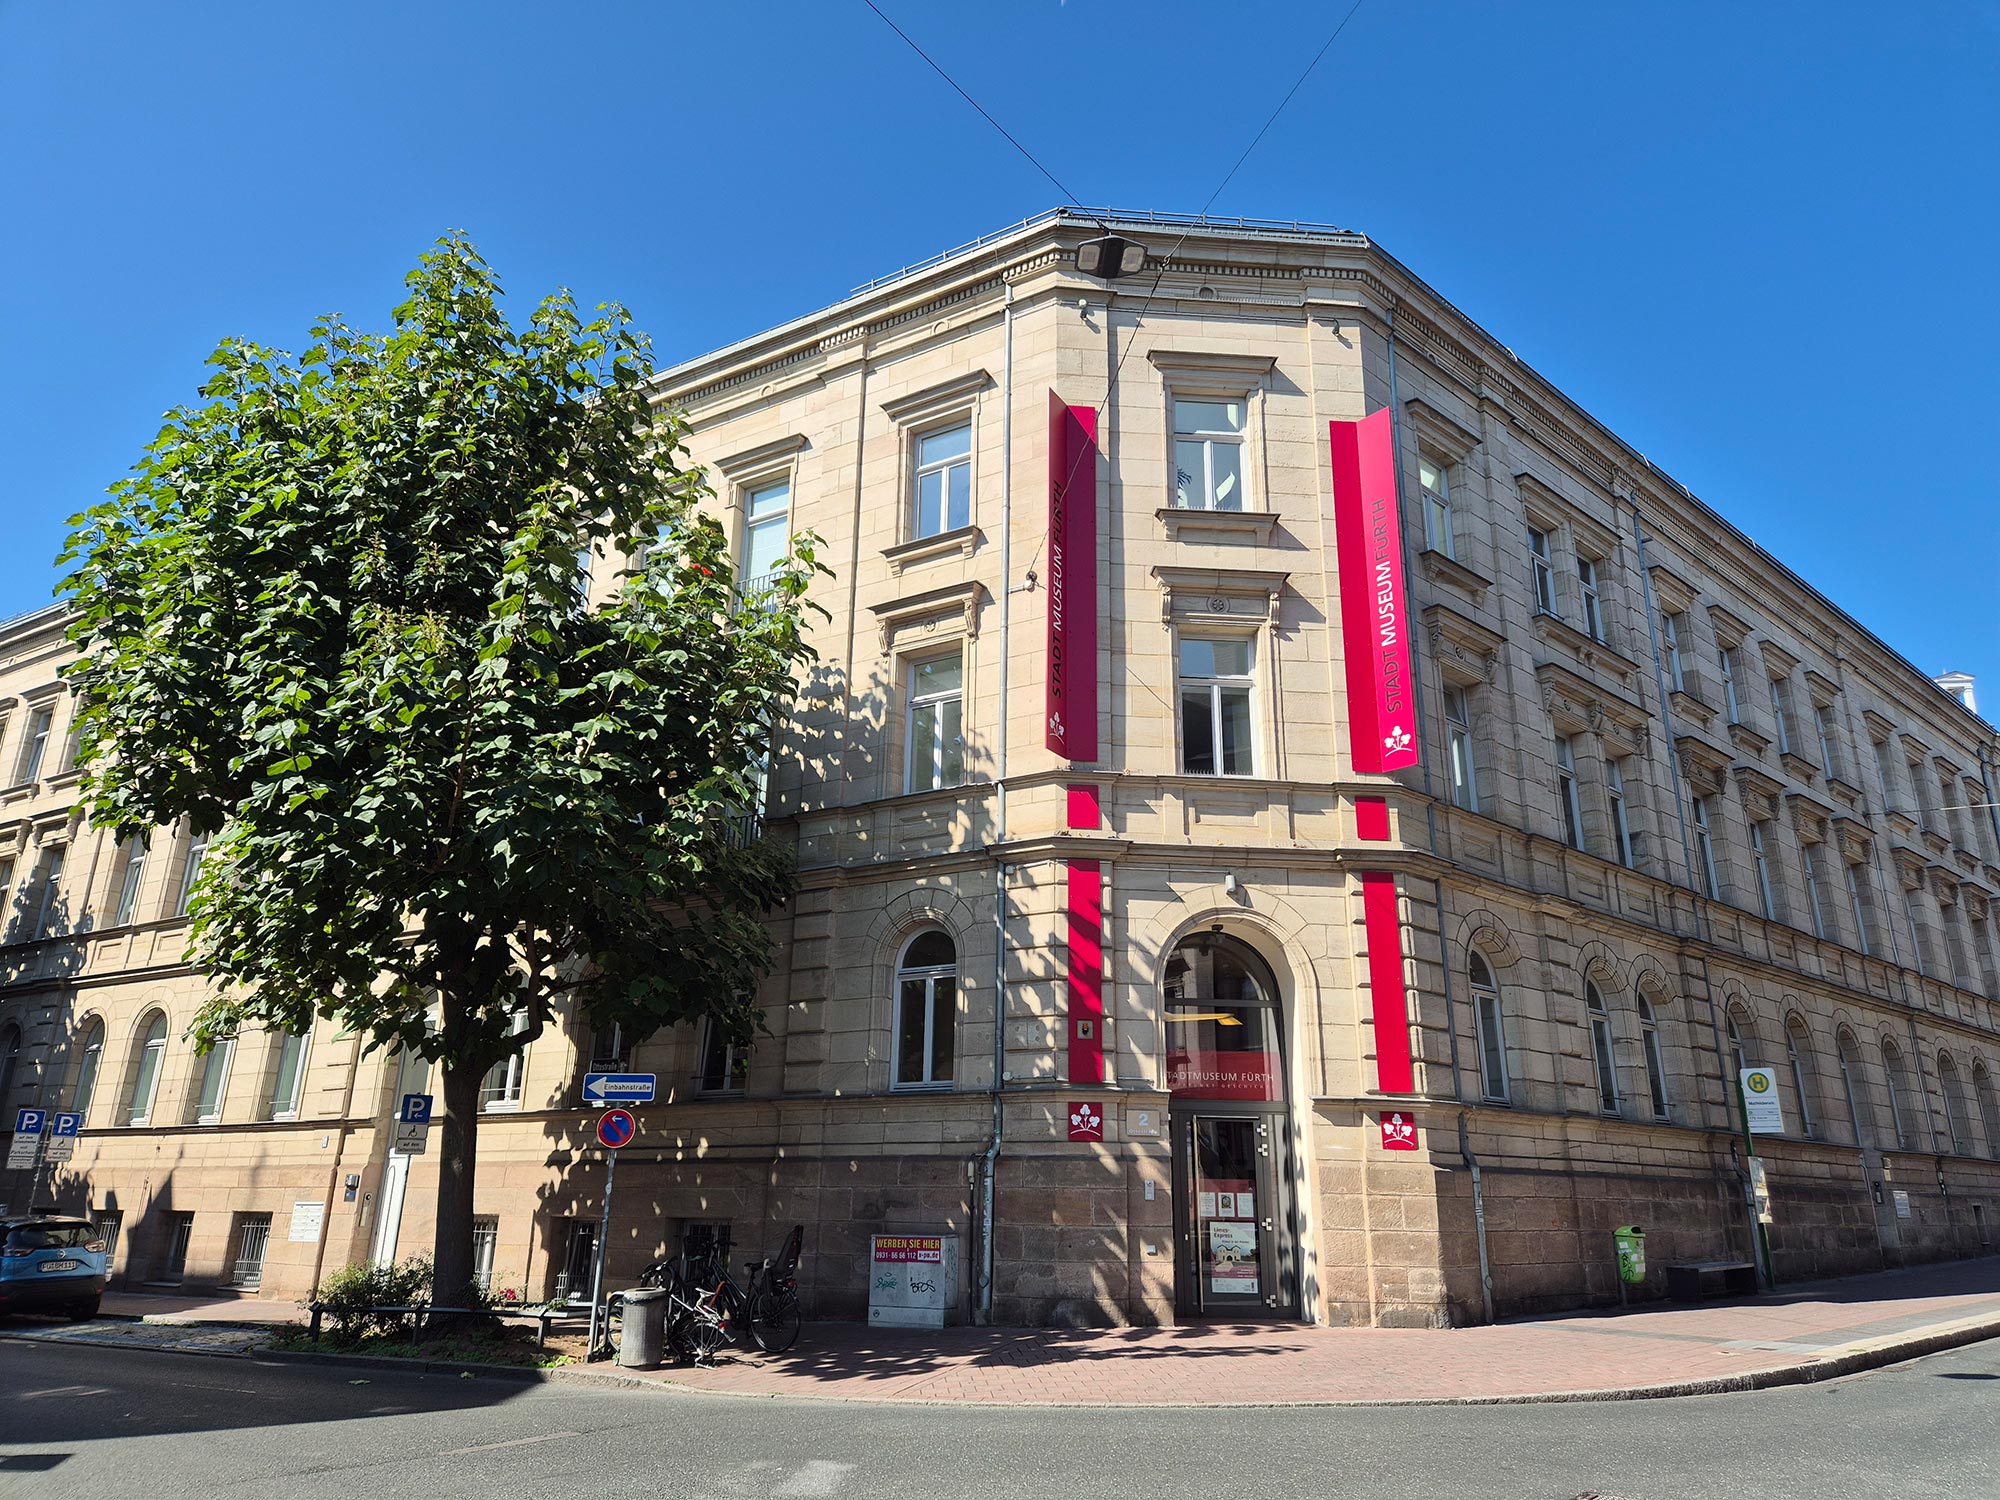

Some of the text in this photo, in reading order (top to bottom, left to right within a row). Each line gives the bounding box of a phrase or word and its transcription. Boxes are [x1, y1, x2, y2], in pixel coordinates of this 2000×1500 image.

[1052, 544, 1063, 631] MUSEUM
[1376, 561, 1397, 647] MUSEUM
[1052, 632, 1062, 698] STADT
[1382, 649, 1402, 713] STADT
[1166, 1071, 1274, 1081] TADTMUSEUM FÜRTH
[604, 1083, 651, 1091] Einbahnstraße
[407, 1097, 425, 1119] P
[22, 1113, 38, 1130] P
[58, 1116, 73, 1133] P
[1139, 1113, 1149, 1126] 2
[876, 1239, 940, 1249] WERBEN SIE HIER
